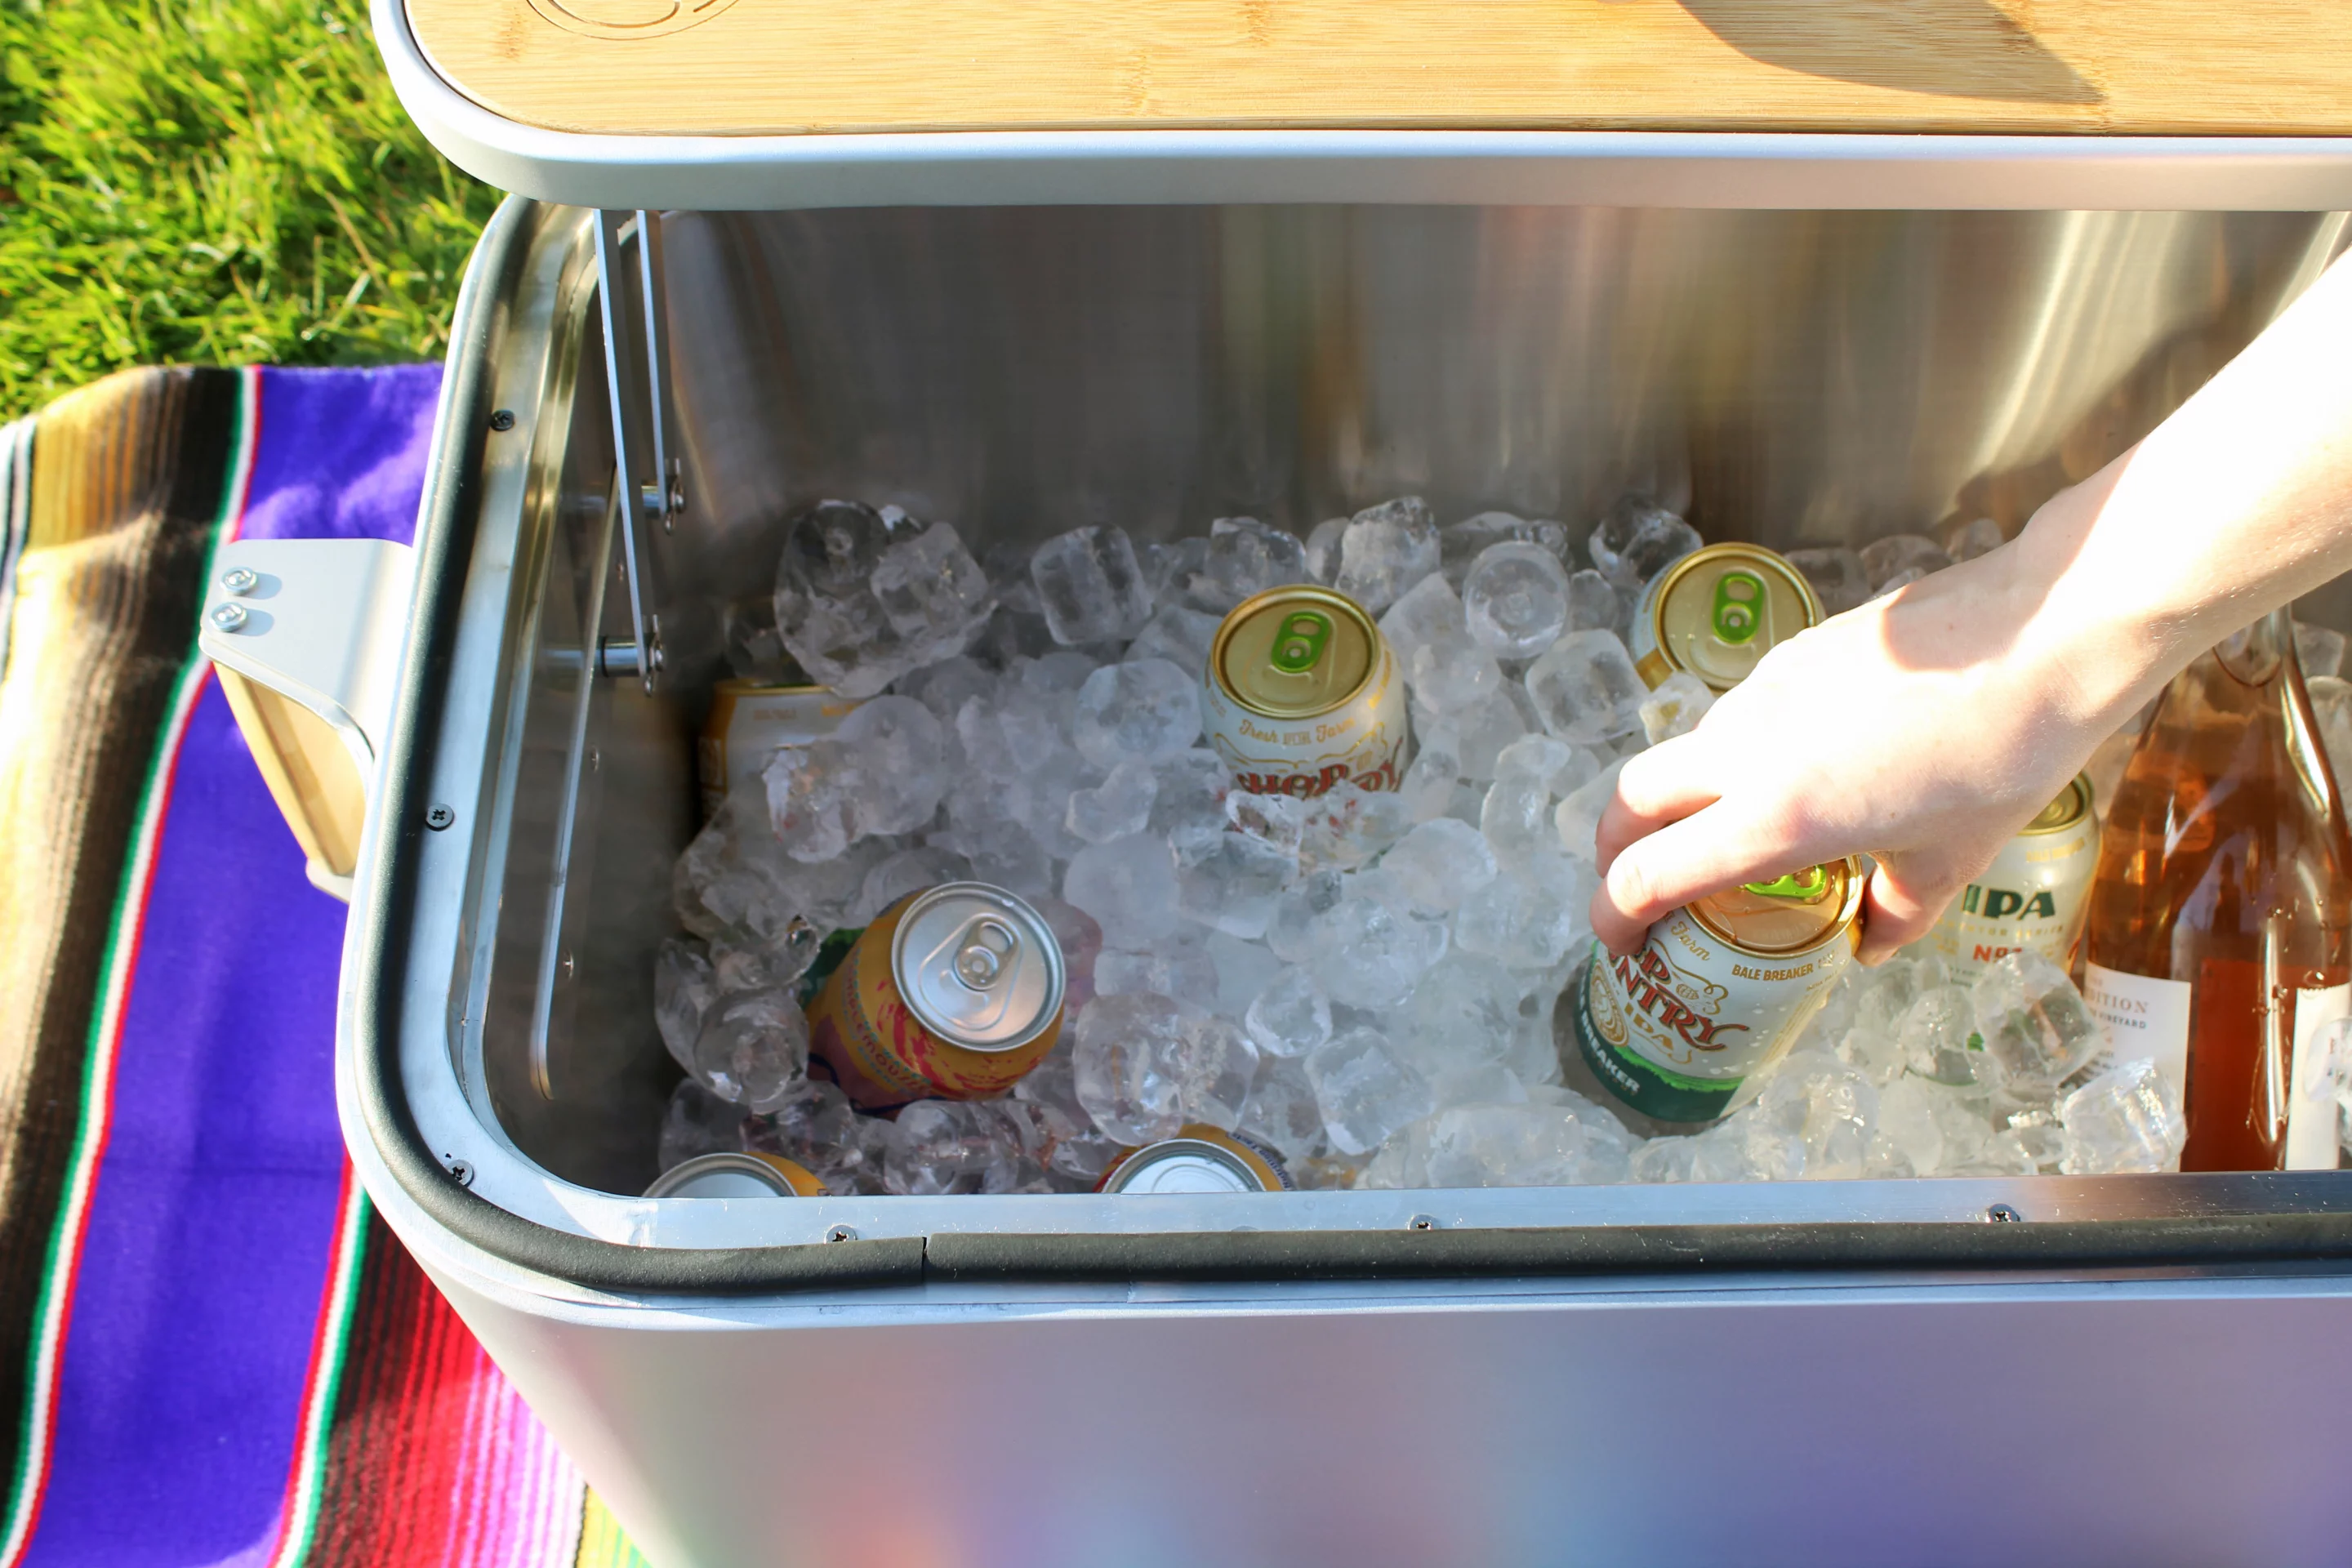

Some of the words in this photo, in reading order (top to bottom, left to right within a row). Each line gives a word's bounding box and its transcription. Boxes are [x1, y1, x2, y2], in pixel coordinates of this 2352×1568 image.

[1962, 883, 2056, 922] IPA
[1670, 920, 1711, 962] Farm
[1731, 964, 1762, 981] BALE
[1762, 963, 1815, 982] BREAKER
